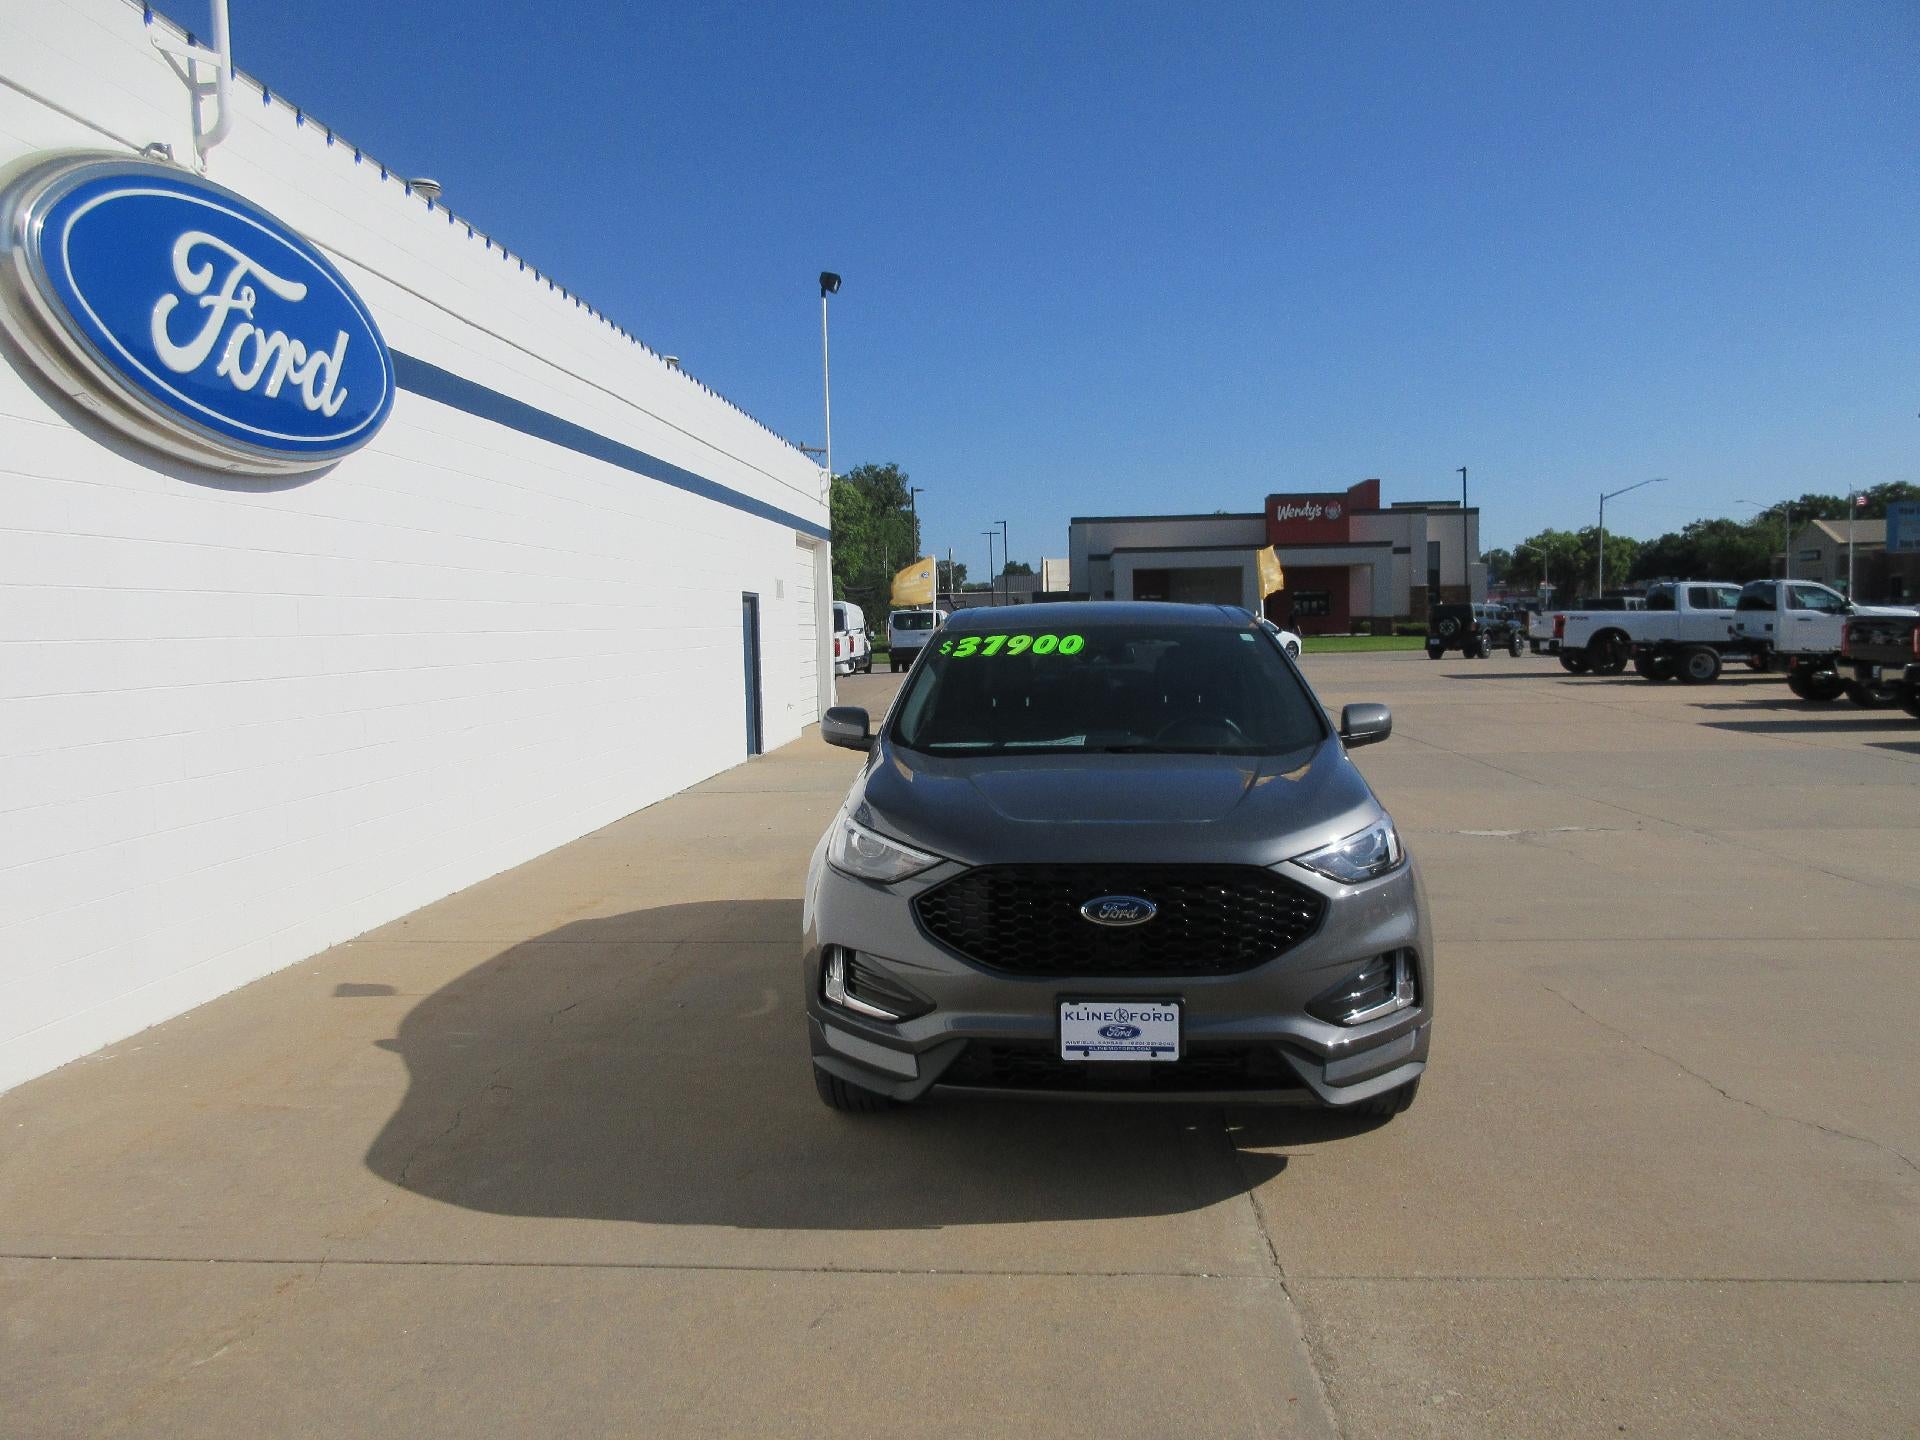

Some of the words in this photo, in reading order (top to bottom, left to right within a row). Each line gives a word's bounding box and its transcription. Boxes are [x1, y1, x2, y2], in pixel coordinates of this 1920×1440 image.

[151, 231, 350, 417] Ford
[1277, 501, 1322, 521] Wendy's
[938, 634, 1086, 658] $37900
[1099, 902, 1139, 919] Ford
[1065, 1011, 1114, 1021] KLINE
[1130, 1012, 1175, 1022] FORD
[1106, 1025, 1133, 1038] Ford
